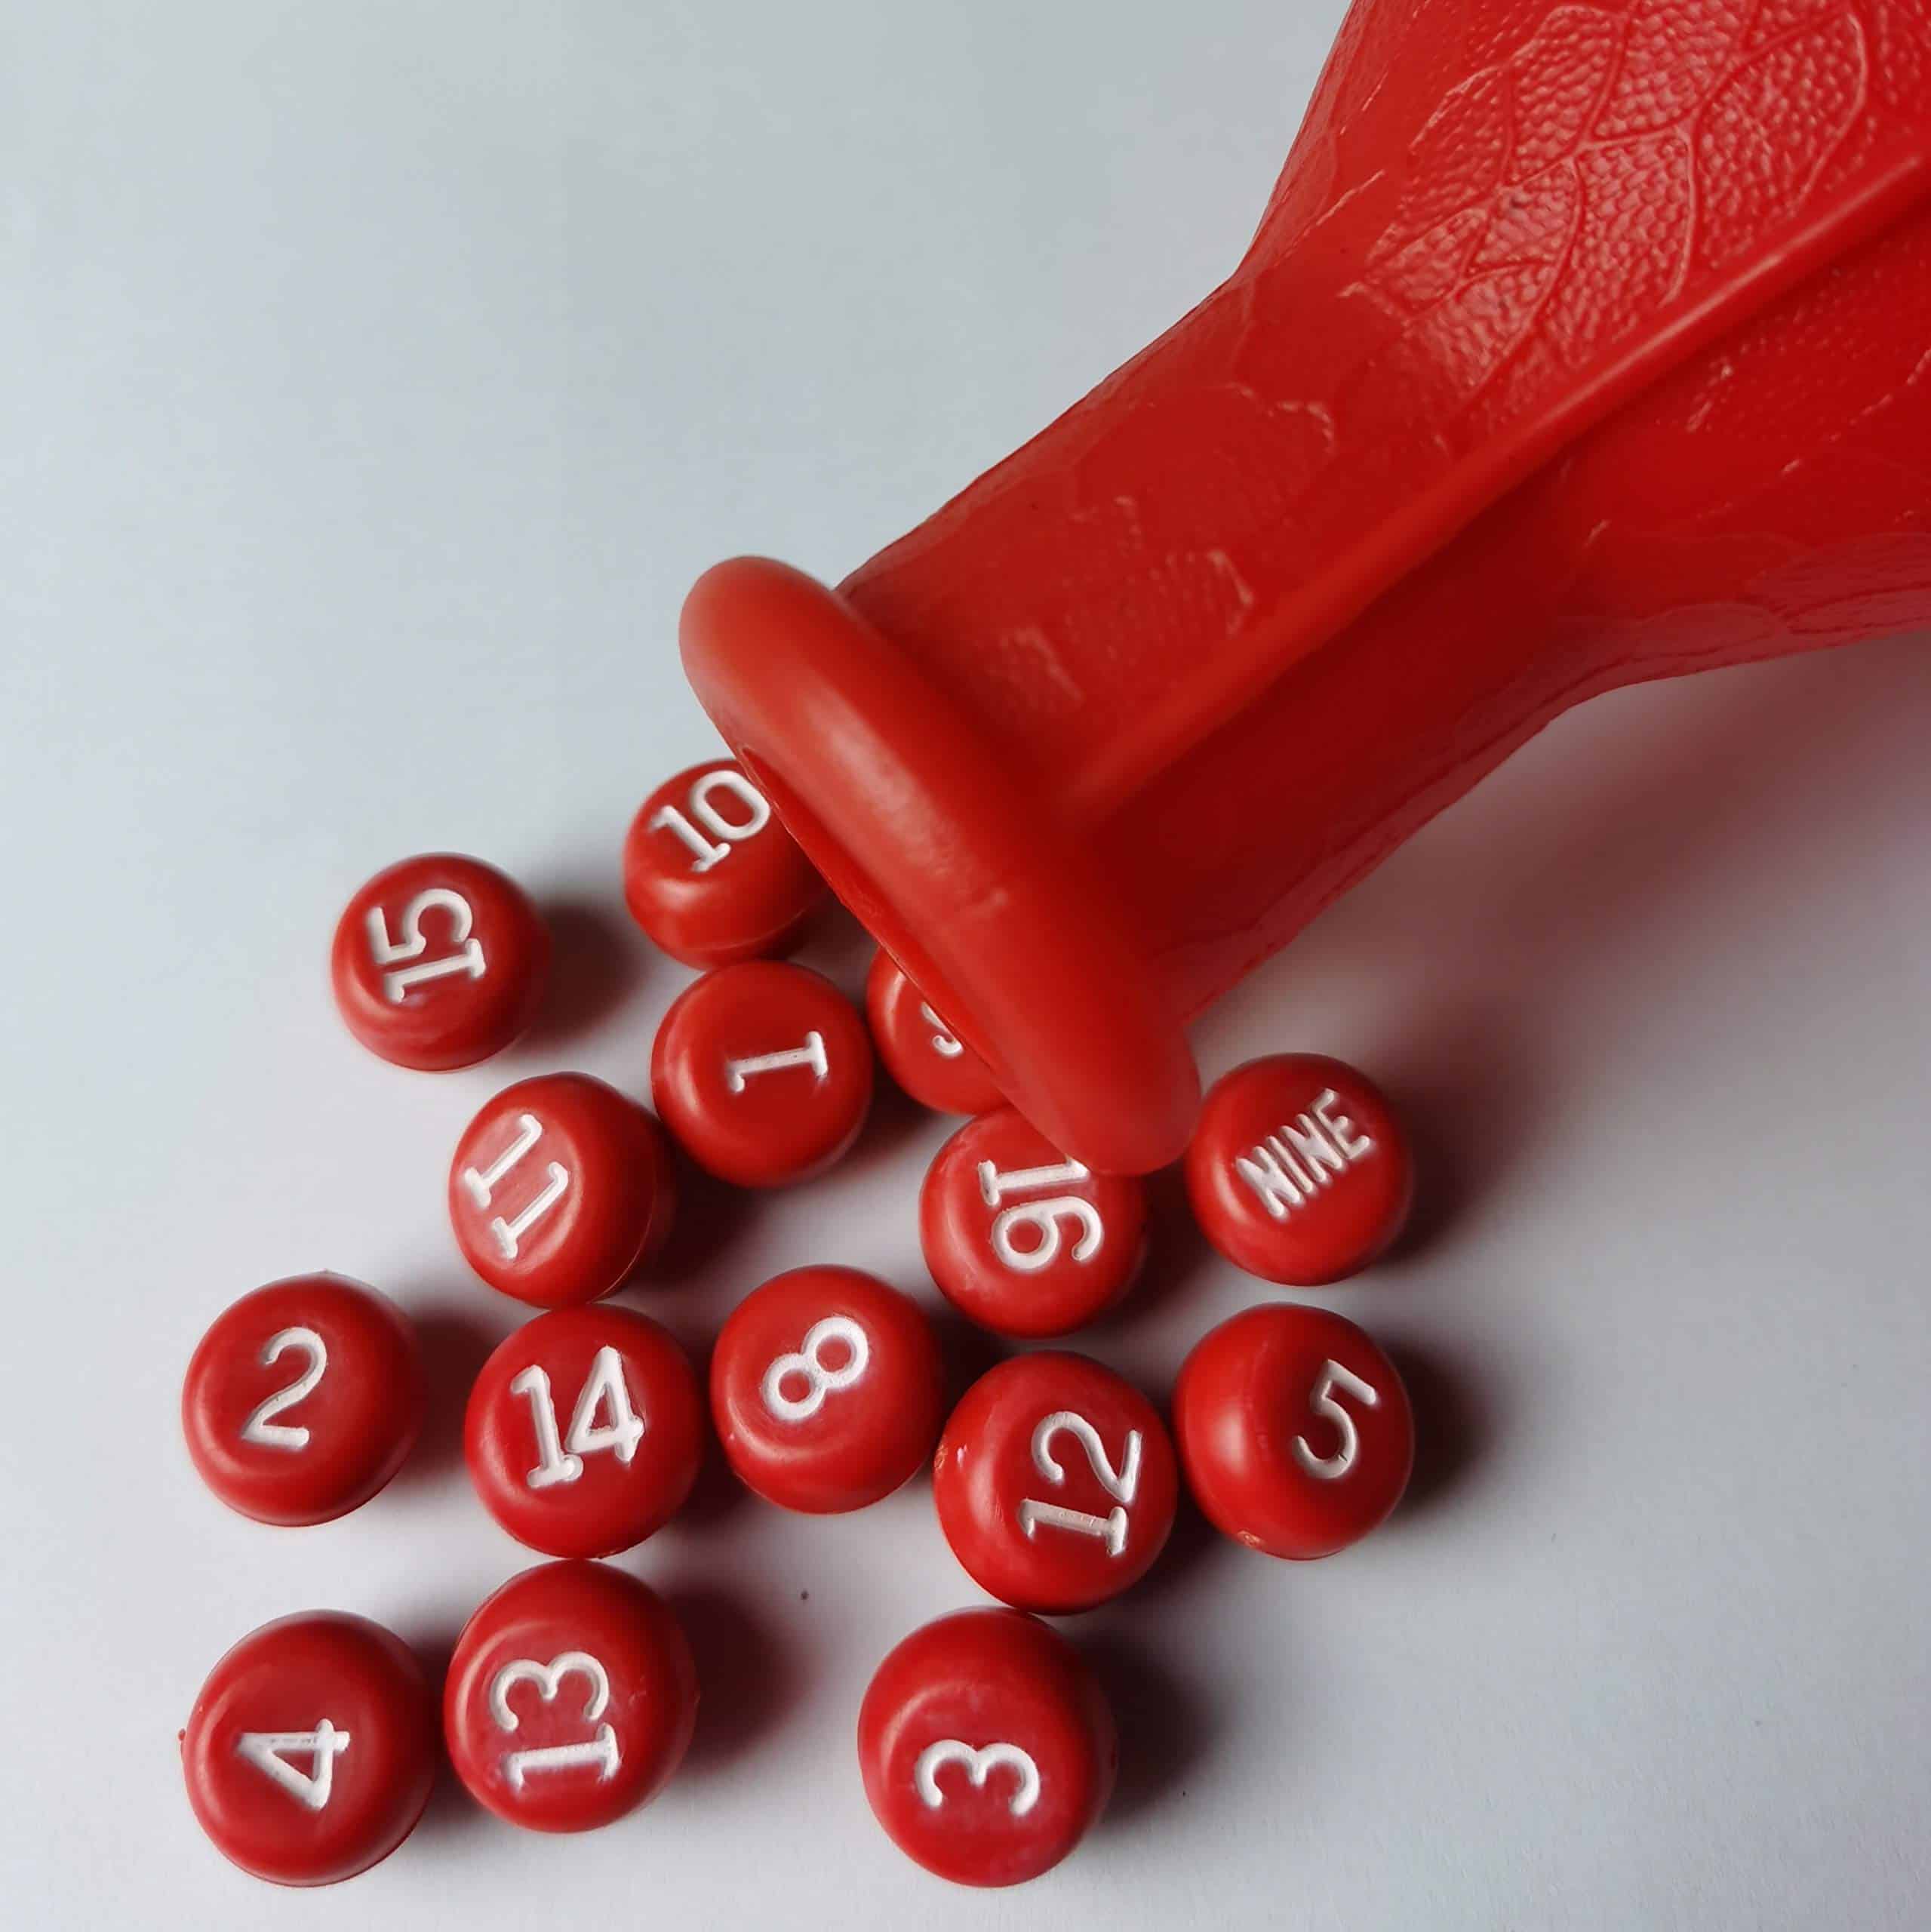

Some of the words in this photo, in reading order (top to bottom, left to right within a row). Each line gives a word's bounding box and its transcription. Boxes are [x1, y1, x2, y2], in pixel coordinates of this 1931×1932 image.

[649, 769, 772, 872] 10
[366, 887, 487, 1004] 15
[730, 1031, 829, 1094] 1
[463, 1113, 570, 1260] 11
[1235, 1088, 1373, 1220] NINE
[977, 1155, 1105, 1272] 16
[242, 1326, 330, 1451] 2
[509, 1346, 646, 1489] 14
[764, 1314, 872, 1423] 8
[1294, 1359, 1377, 1478] 5
[1021, 1411, 1142, 1556] 12
[240, 1718, 352, 1811] 4
[488, 1649, 622, 1792] 13
[917, 1739, 1041, 1817] 3
